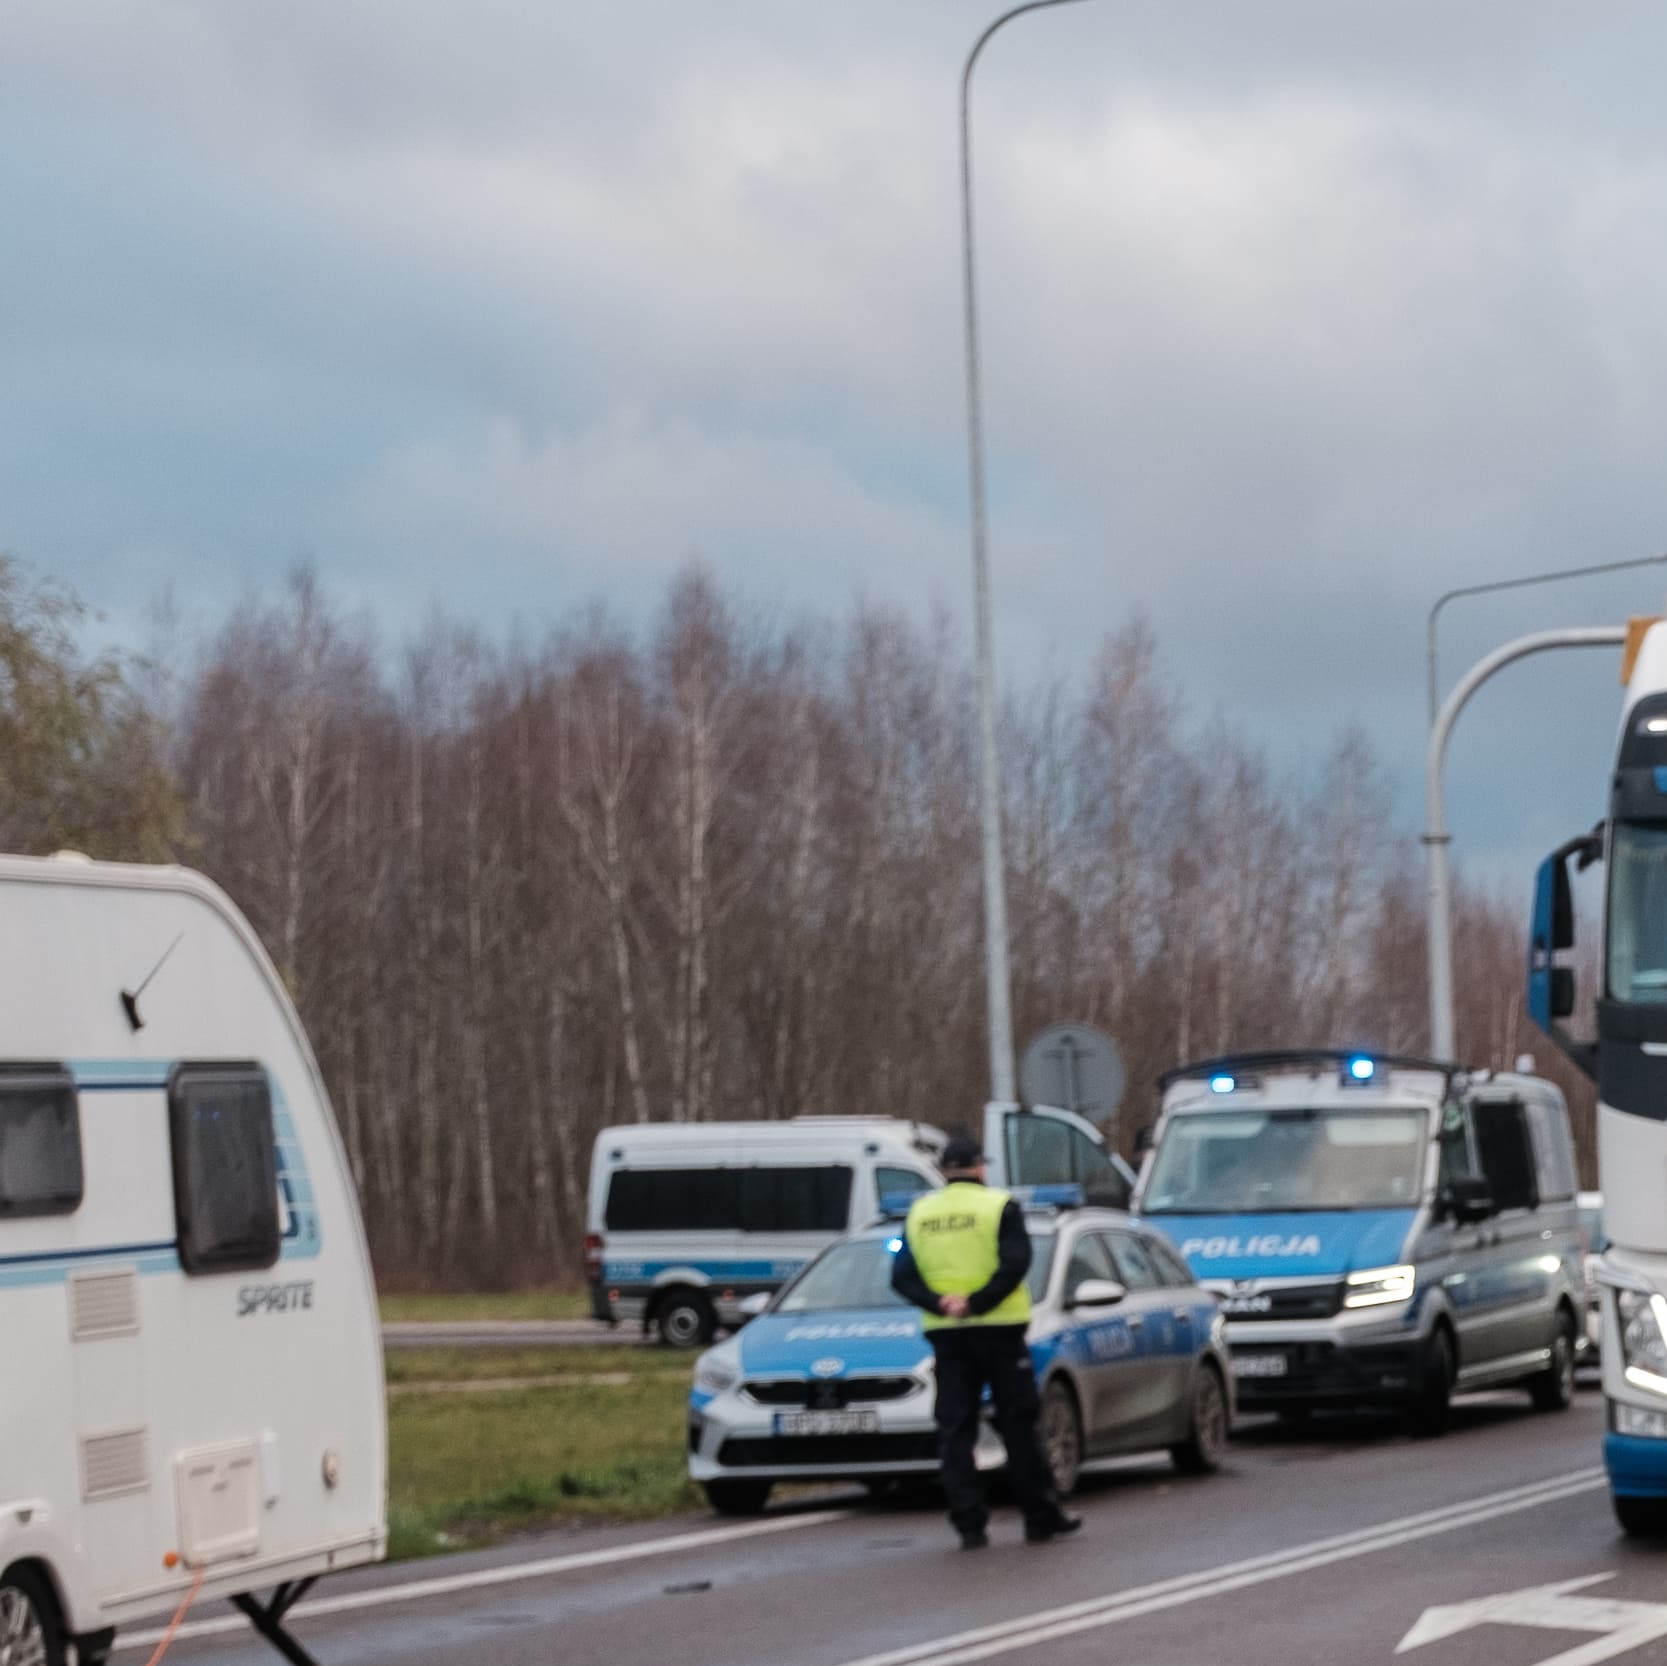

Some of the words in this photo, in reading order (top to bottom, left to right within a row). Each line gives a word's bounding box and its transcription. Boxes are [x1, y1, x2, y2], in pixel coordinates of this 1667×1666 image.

[1179, 1233, 1321, 1259] POLICJA
[237, 1279, 315, 1317] SPRITE
[784, 1321, 916, 1343] POLICJA
